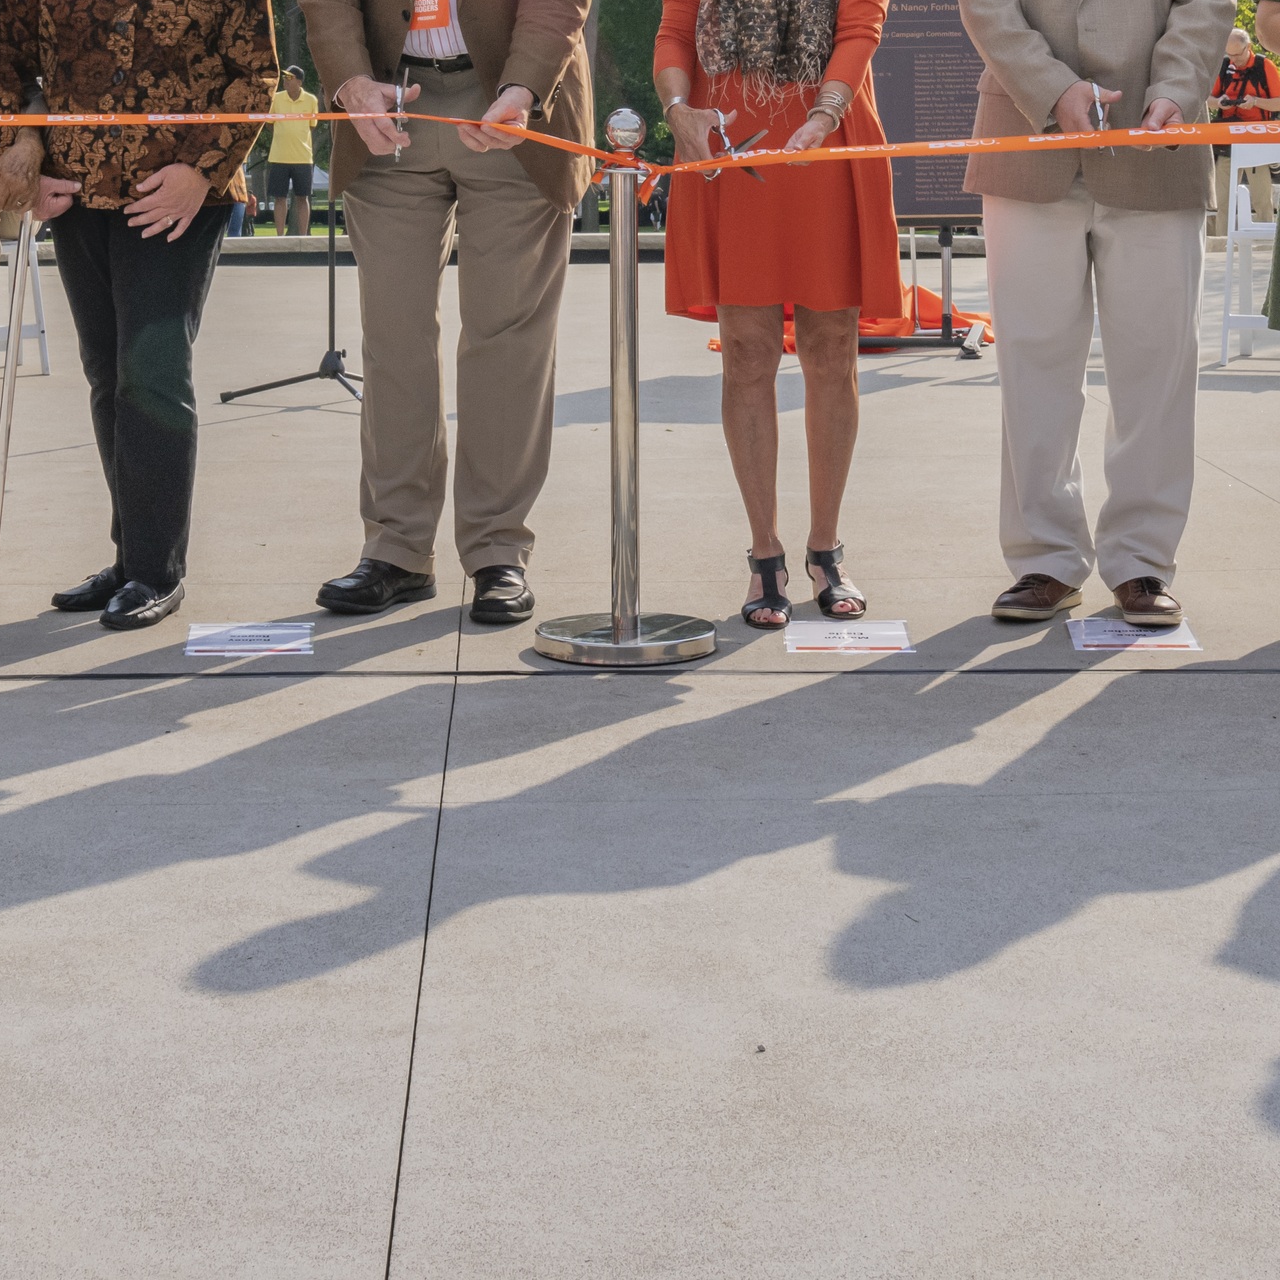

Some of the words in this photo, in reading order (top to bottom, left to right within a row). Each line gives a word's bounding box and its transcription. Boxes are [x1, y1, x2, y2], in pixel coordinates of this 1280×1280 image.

[414, 5, 439, 13] ROGERS
[891, 3, 899, 12] &
[901, 4, 928, 13] Nancy
